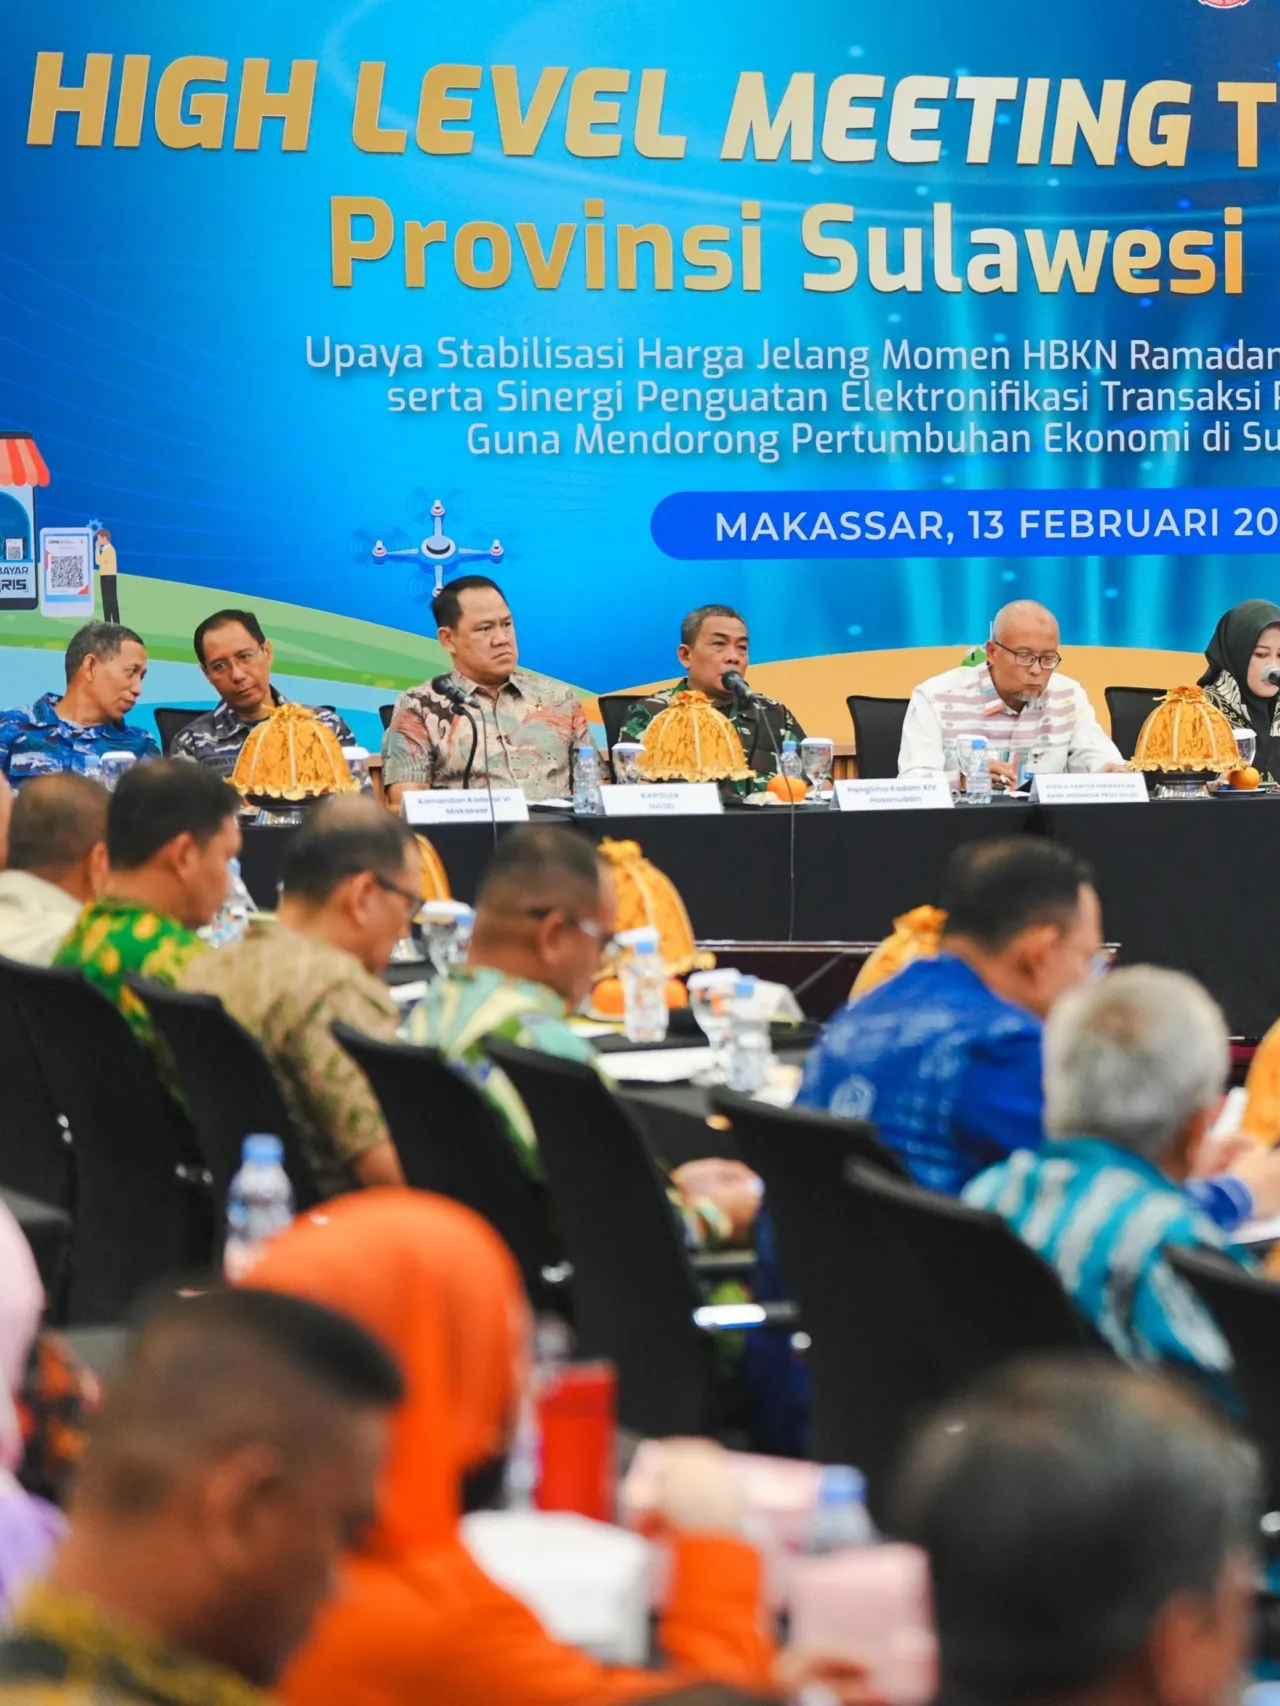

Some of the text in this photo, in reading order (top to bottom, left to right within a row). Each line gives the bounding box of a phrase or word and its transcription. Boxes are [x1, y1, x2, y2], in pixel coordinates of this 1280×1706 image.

[26, 52, 318, 152] HIGH
[351, 61, 687, 159] LEVEL
[720, 71, 1192, 167] MEETING
[330, 196, 762, 292] Provinsi
[801, 201, 1243, 294] Sulawesi
[305, 336, 423, 377] Upaya
[437, 336, 625, 369] Stabilisasi
[638, 338, 744, 379] Harga
[757, 338, 870, 379] Jelang
[883, 339, 1010, 370] Momen
[1024, 339, 1118, 370] HBKN
[387, 384, 483, 413] serta
[497, 380, 623, 421] Sinergi
[637, 381, 827, 421] Penguatan
[842, 380, 1088, 412] Elektronifikasi
[1100, 380, 1261, 411] Transaksi
[467, 423, 561, 455] Guna
[574, 423, 780, 463] Mendorong
[792, 422, 1031, 454] Pertumbuhan
[1044, 421, 1190, 453] Ekonomi
[1202, 421, 1230, 452] di
[715, 511, 955, 545] MAKASSAR,
[967, 510, 1004, 539] 13
[1020, 508, 1219, 539] FEBRUARI
[0, 579, 27, 592] RIS
